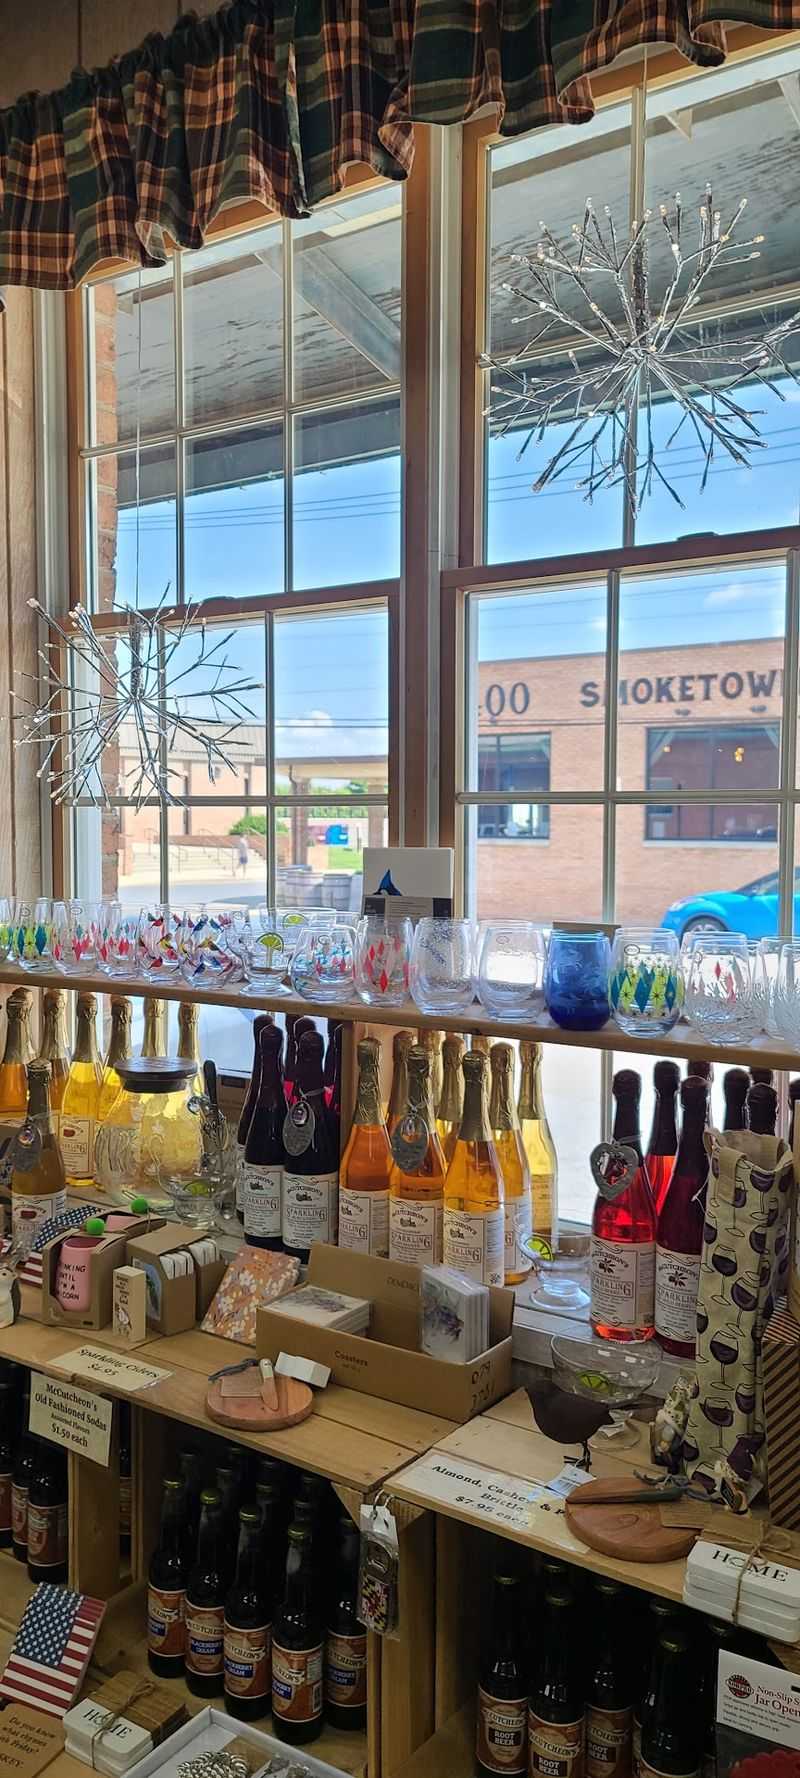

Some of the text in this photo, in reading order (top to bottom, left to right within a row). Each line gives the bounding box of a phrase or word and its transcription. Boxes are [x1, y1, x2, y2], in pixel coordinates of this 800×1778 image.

[579, 668, 786, 707] SOKETOW
[478, 681, 532, 717] 00
[79, 1348, 160, 1379] Sparkling Ciders
[334, 1350, 369, 1367] Coasters
[46, 1383, 97, 1412] McCutcheon's
[35, 1392, 107, 1431] Old Fashioned Sodas
[51, 1423, 88, 1447] $1.50 each
[431, 1464, 483, 1488] Almond,
[539, 1503, 551, 1513] &
[455, 1495, 494, 1514] $7.95
[480, 1492, 525, 1512] Brittle
[712, 1550, 789, 1582] HOME
[754, 1694, 770, 1707] Jar
[757, 1685, 793, 1706] Non-Slip
[494, 1730, 515, 1740] ROOT
[494, 1737, 515, 1746] BEER
[538, 1756, 561, 1769] ROOT
